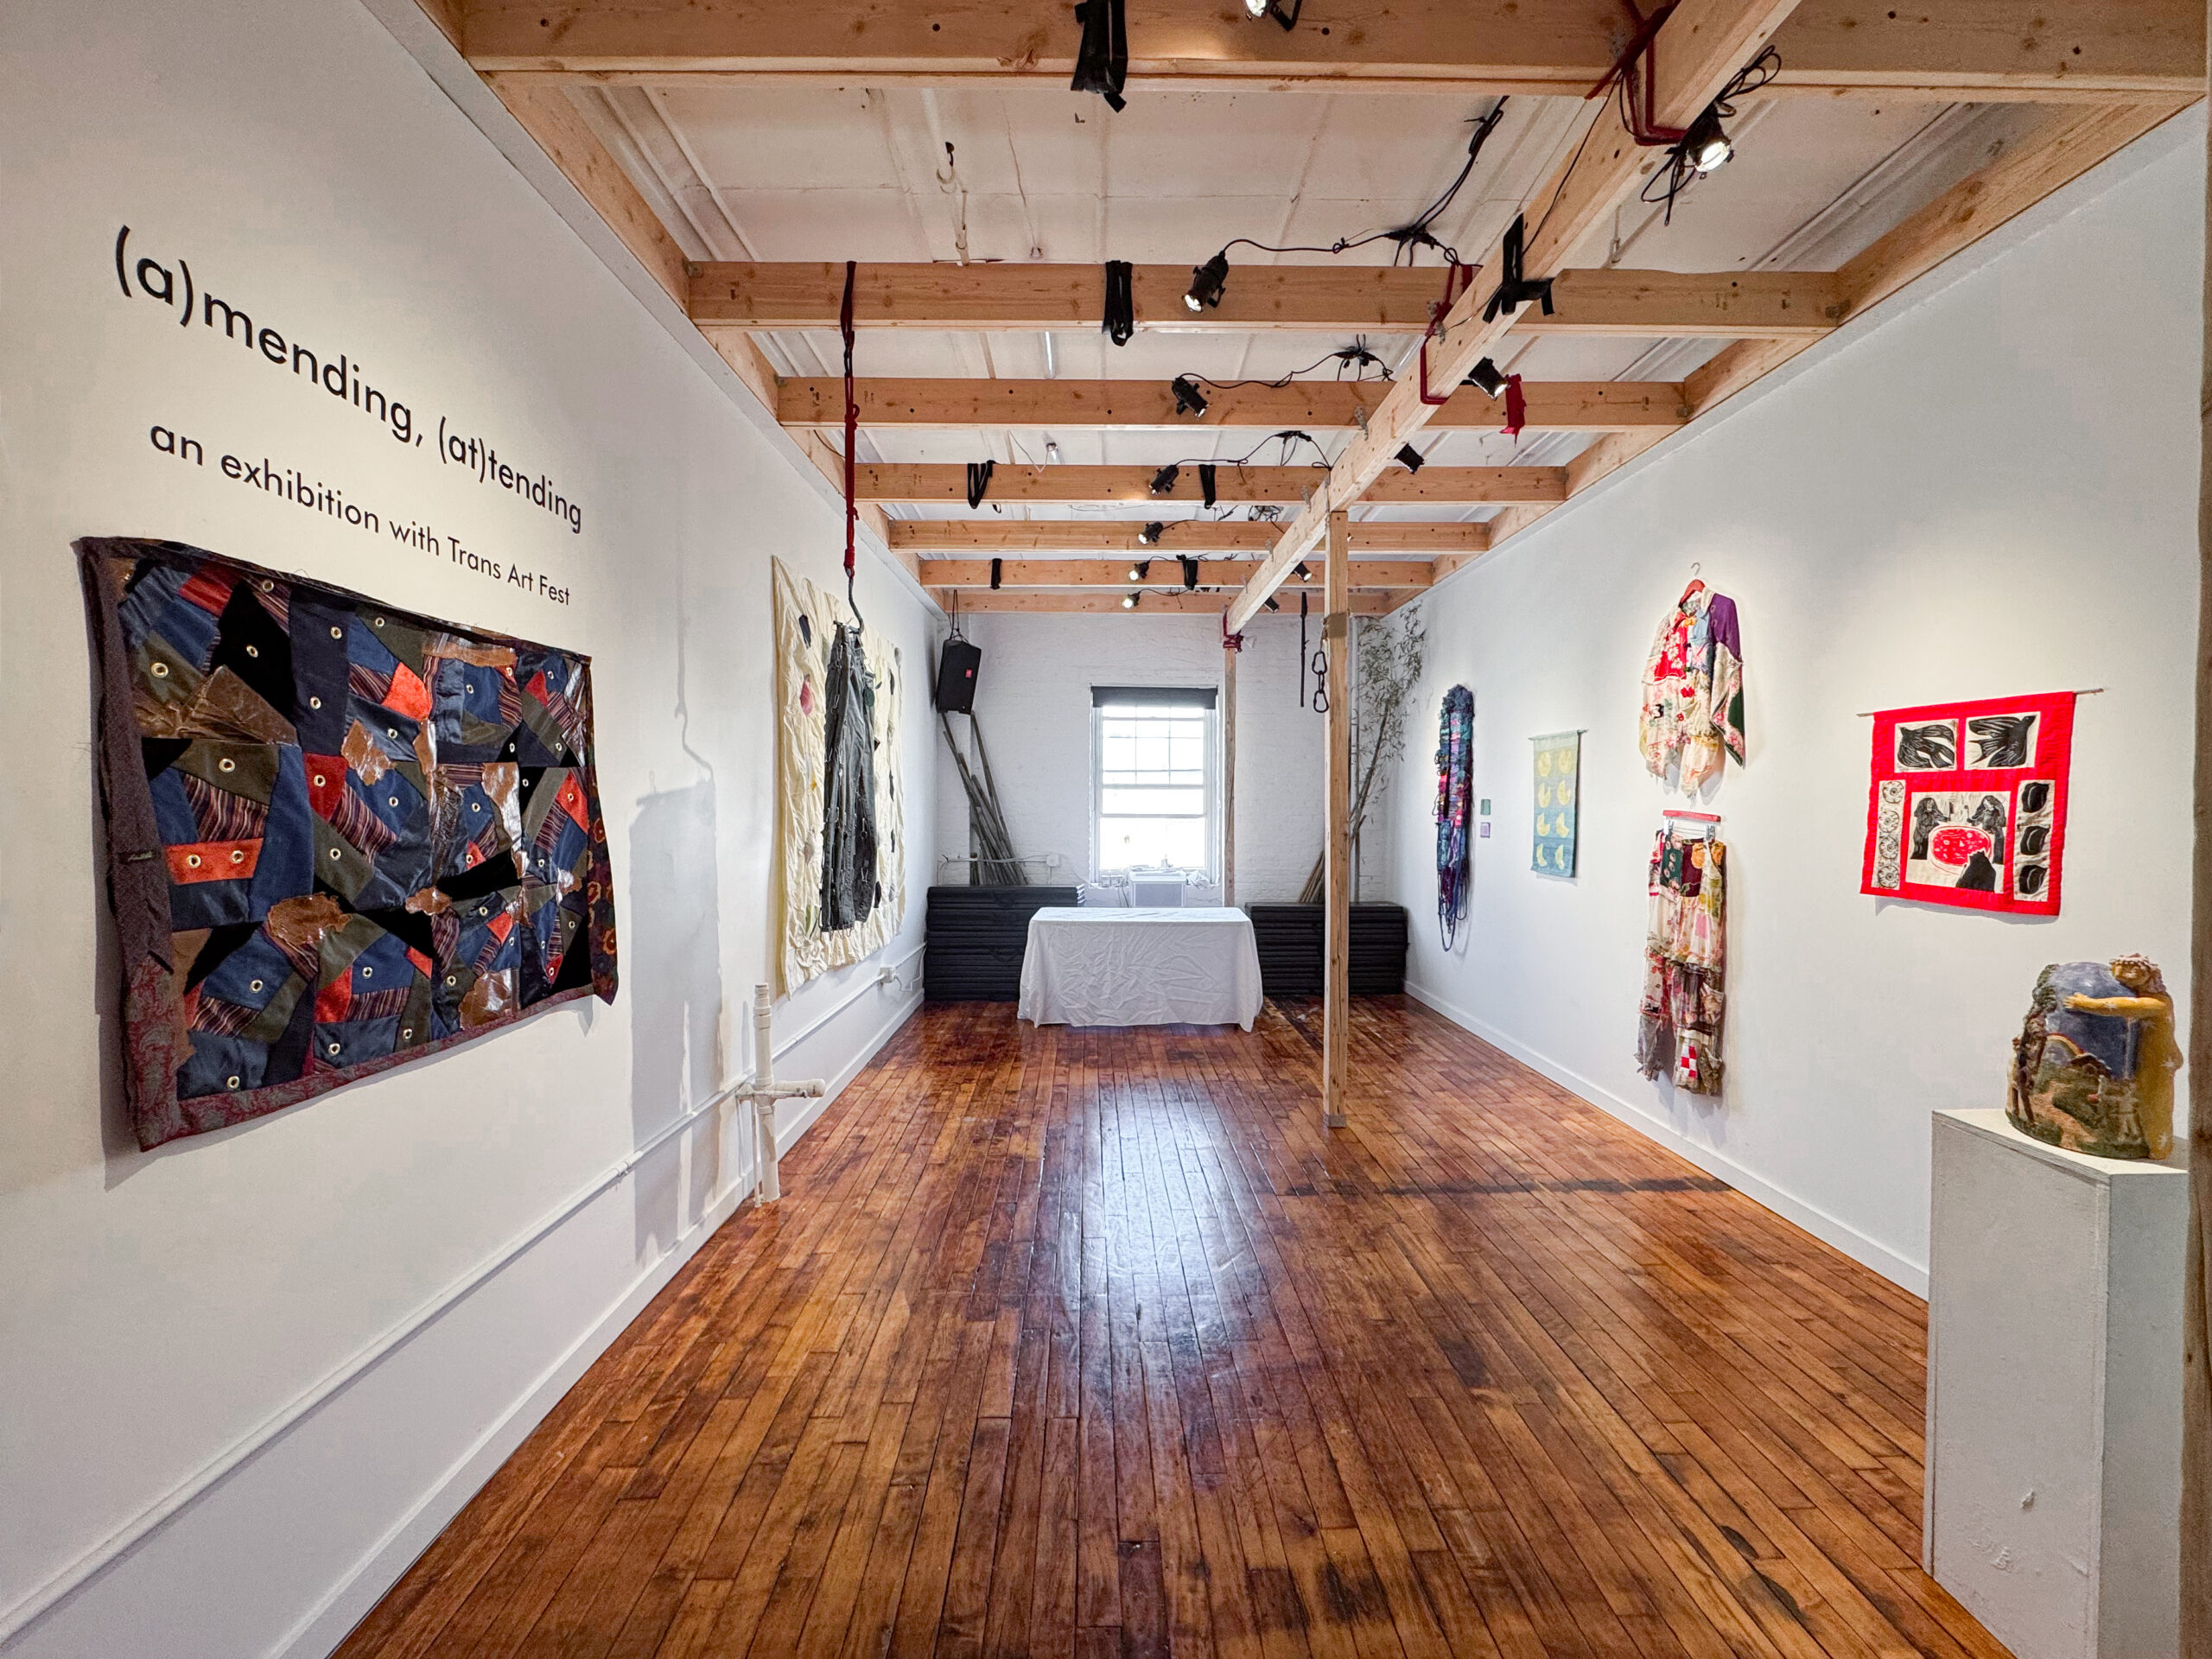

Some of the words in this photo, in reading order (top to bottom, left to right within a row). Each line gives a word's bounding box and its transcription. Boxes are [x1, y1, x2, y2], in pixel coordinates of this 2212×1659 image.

[116, 225, 423, 448] (a)mending,
[439, 416, 582, 534] (at)tending
[150, 426, 203, 466] an
[221, 455, 379, 533] exhibition
[389, 521, 439, 556] with
[448, 537, 501, 579] Trans
[507, 563, 534, 591] Art
[540, 575, 570, 606] Fest
